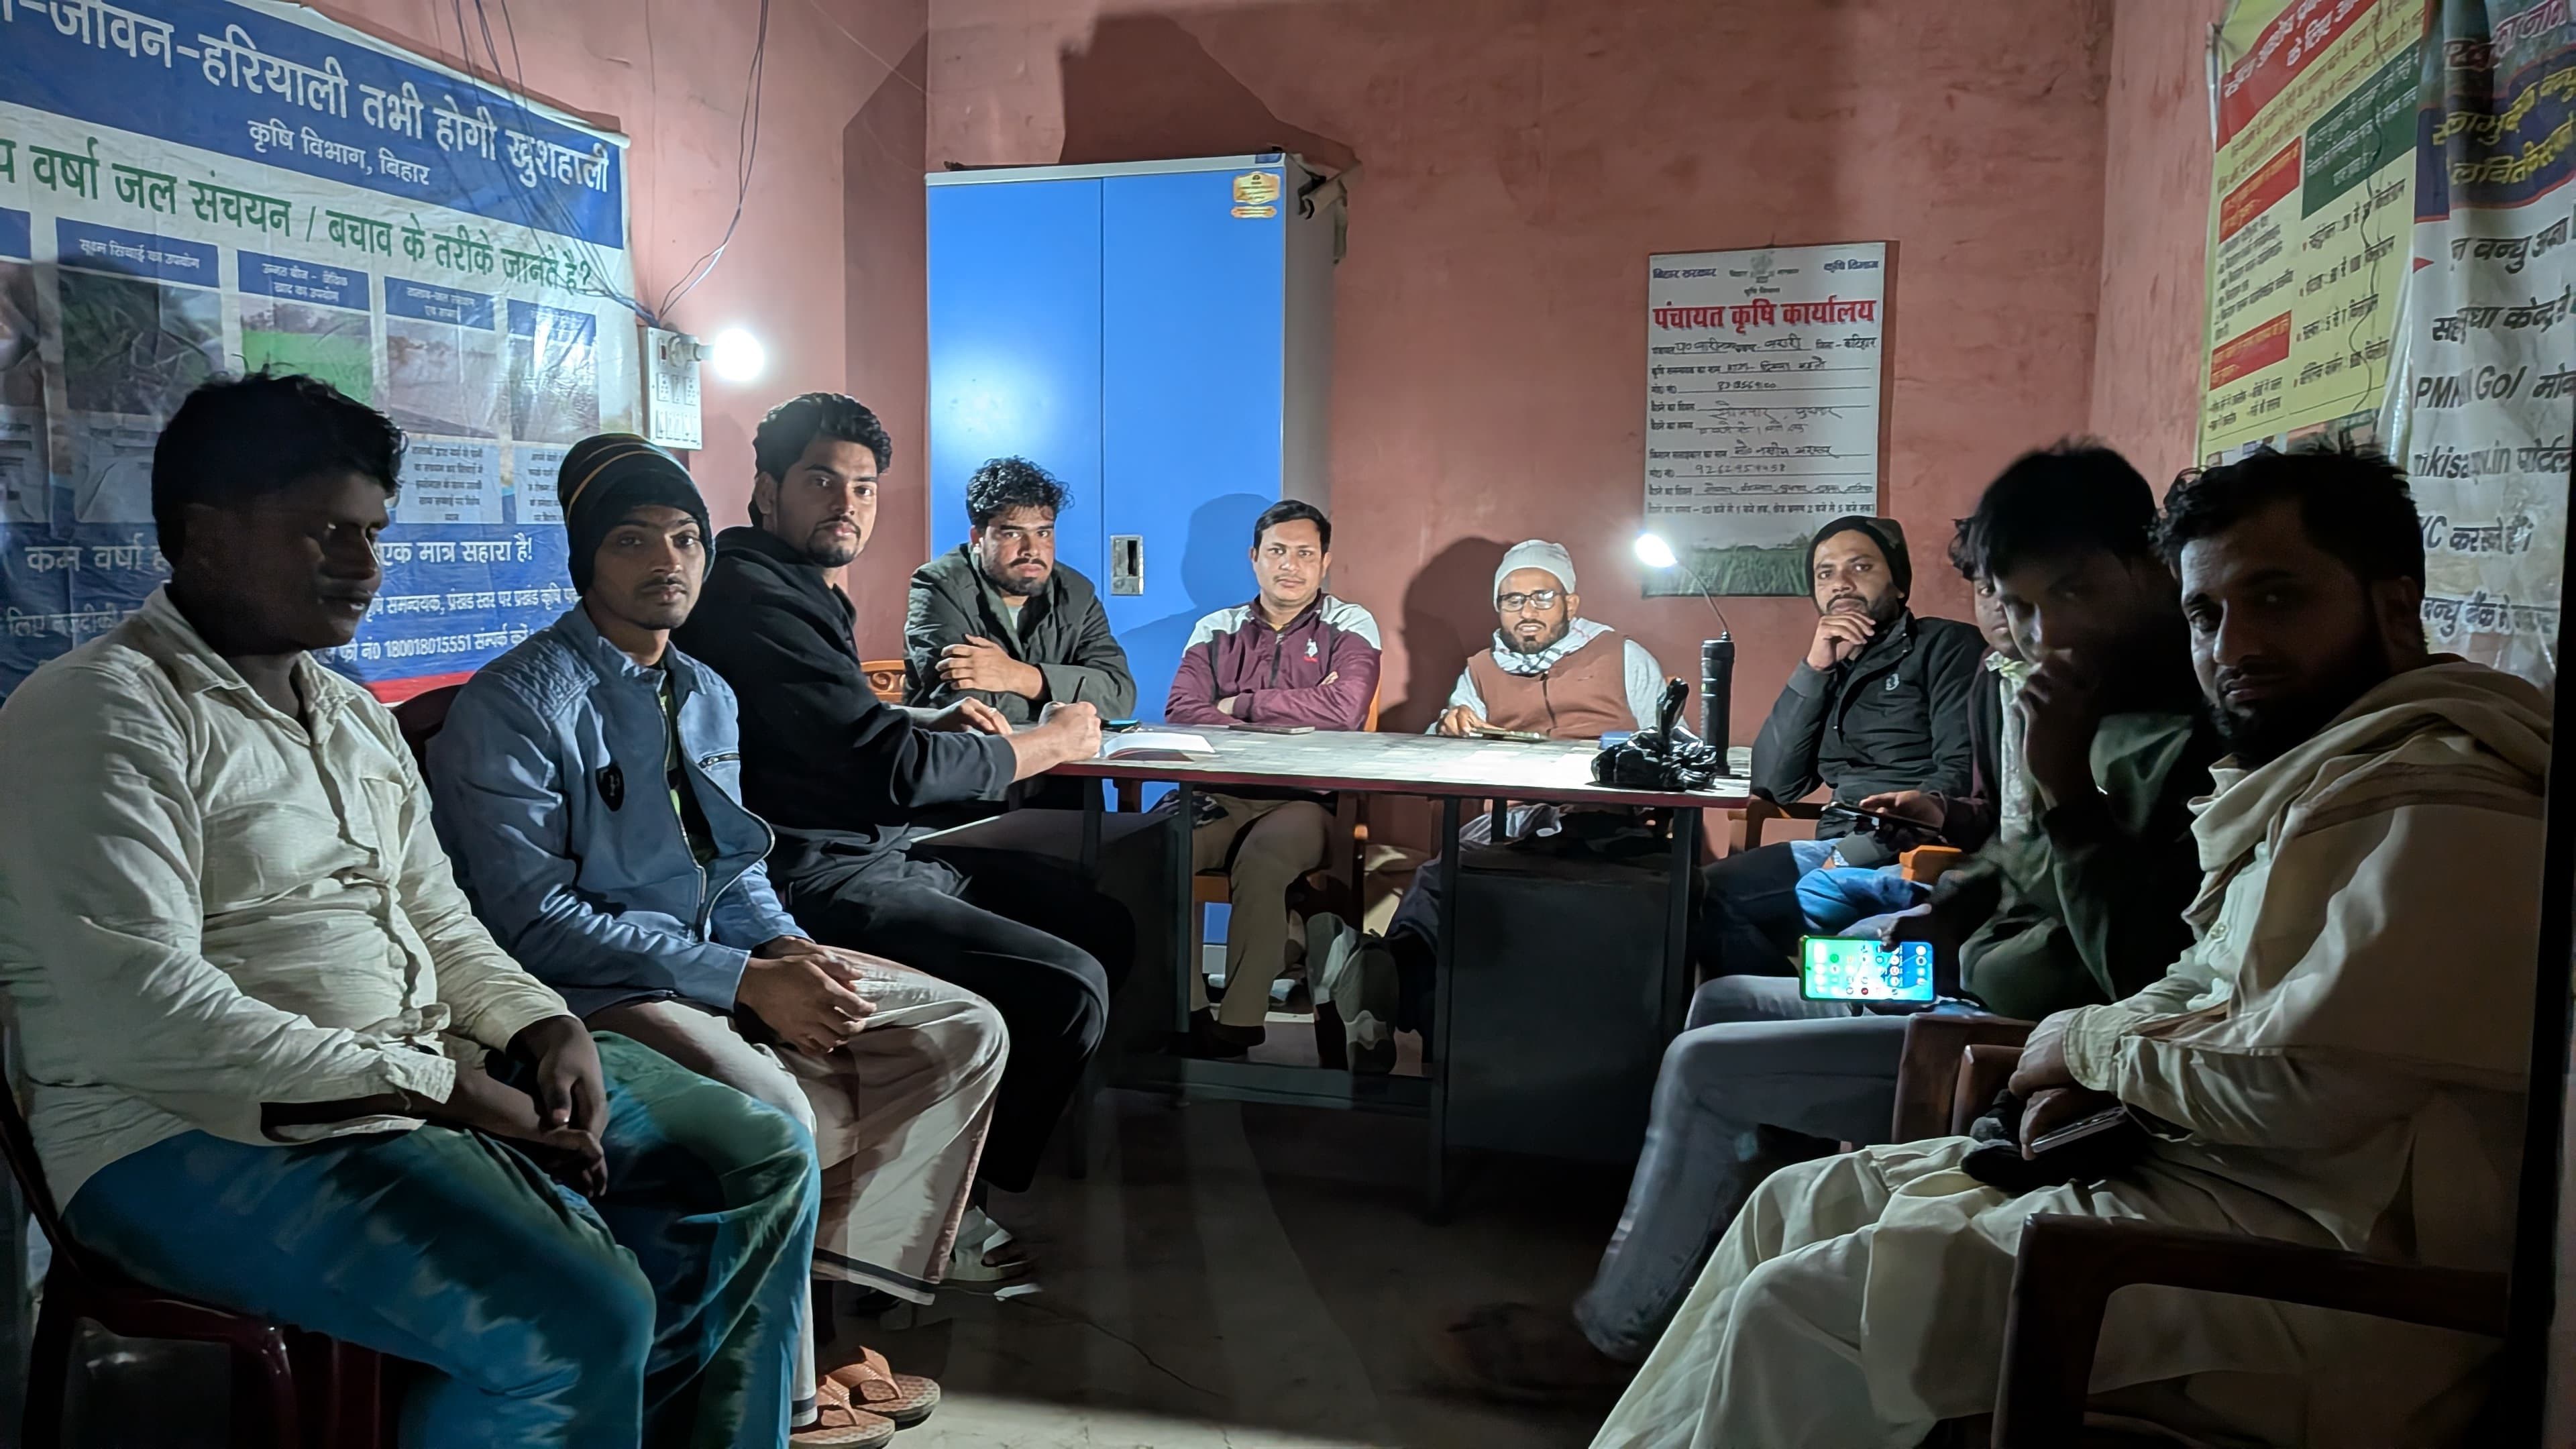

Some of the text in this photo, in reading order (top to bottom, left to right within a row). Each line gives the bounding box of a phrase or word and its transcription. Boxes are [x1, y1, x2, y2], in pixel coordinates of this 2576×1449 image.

[247, 117, 431, 186] कृषि विभाग, बिहार
[359, 81, 424, 140] तभी
[433, 95, 498, 161] होगी
[505, 129, 610, 193] खुशहाली
[29, 136, 101, 200] वर्षा
[111, 162, 178, 215] जल
[188, 170, 292, 237] संचयन
[325, 209, 393, 258] बचाव
[400, 212, 426, 262] के
[432, 223, 494, 276] तरीके
[500, 244, 560, 290] जानते
[1652, 295, 1878, 335] पंचायत कृषि कार्यालय
[25, 545, 84, 573] कम
[91, 533, 146, 571] वर्षा
[377, 532, 533, 566] एक मात्र सहारा है!
[474, 592, 496, 609] स्तर
[497, 590, 513, 607] पर
[539, 582, 561, 610] कृषि
